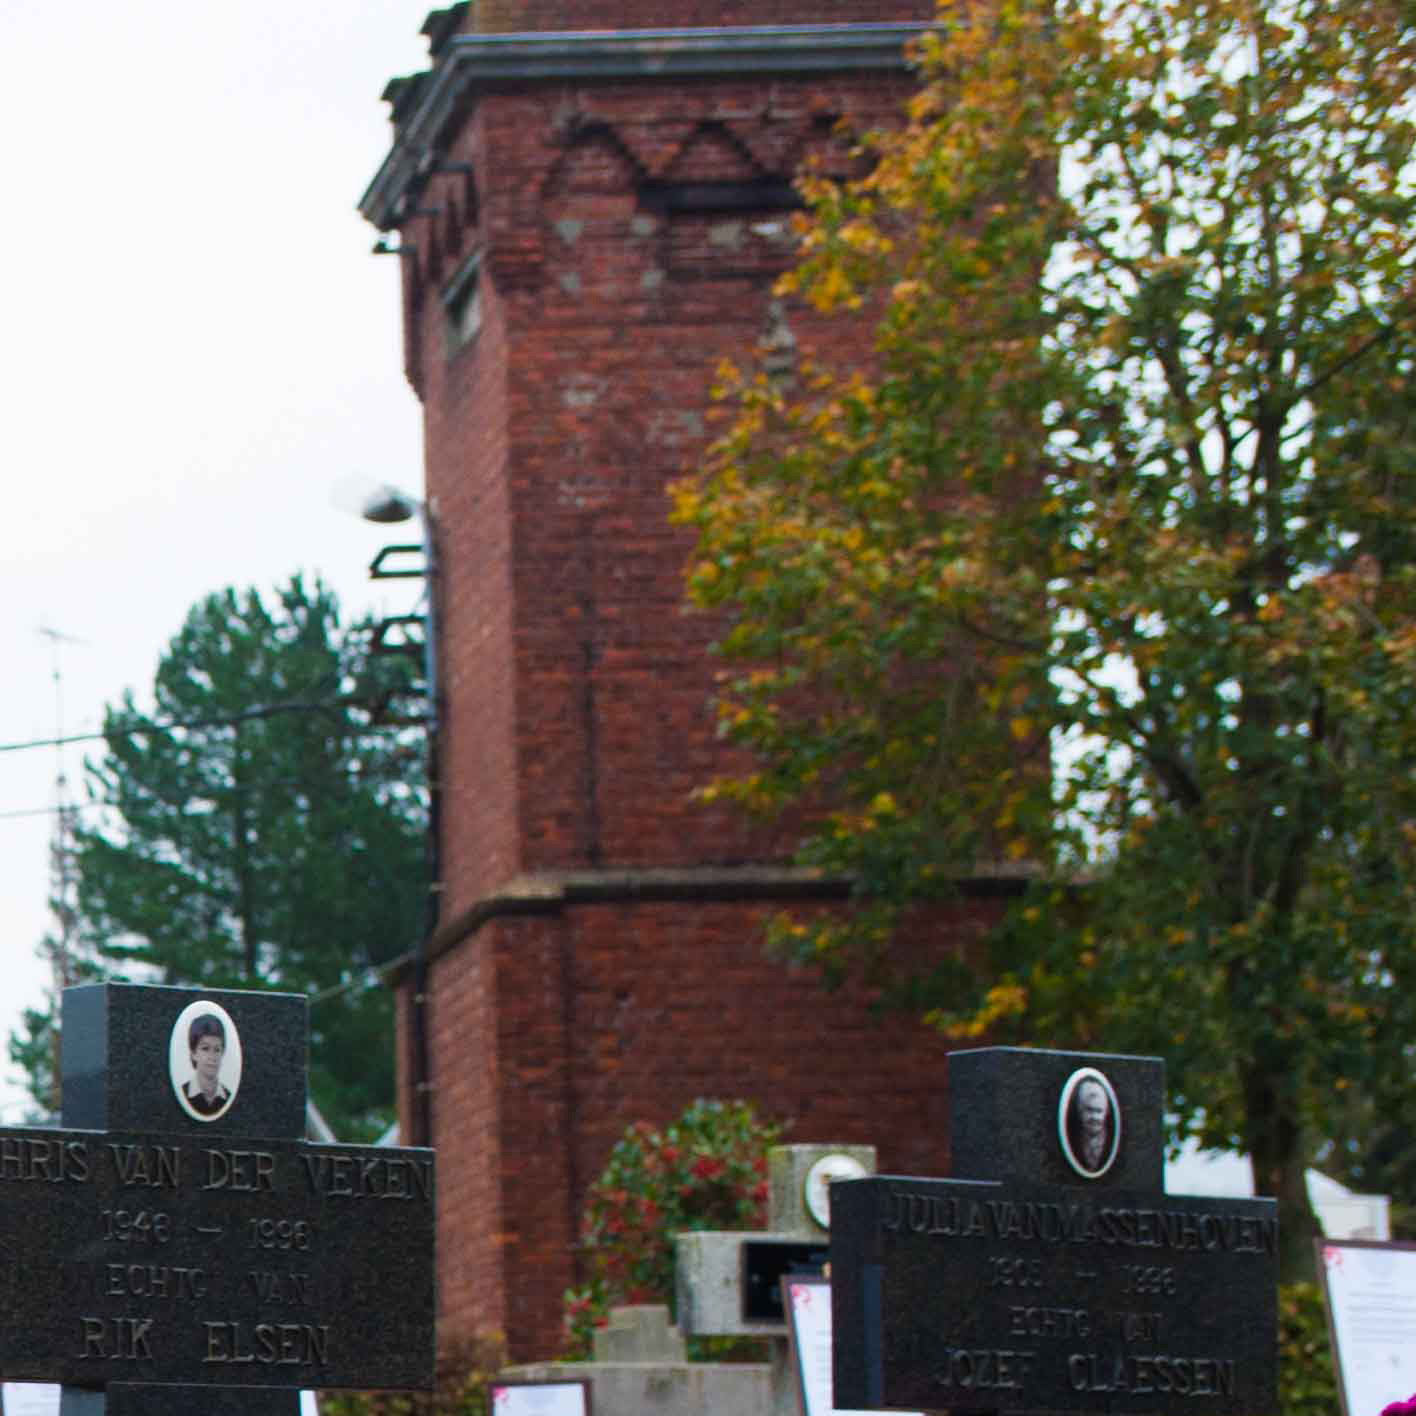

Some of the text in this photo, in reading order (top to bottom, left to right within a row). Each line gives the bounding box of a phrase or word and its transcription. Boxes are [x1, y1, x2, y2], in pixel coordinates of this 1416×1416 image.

[105, 1142, 182, 1192] VAN
[198, 1147, 276, 1194] DER
[296, 1151, 433, 1202] VEKEN
[248, 1270, 312, 1305] VAN
[77, 1314, 331, 1368] RIK ELSEN
[1067, 1352, 1236, 1399] CLAESSEN
